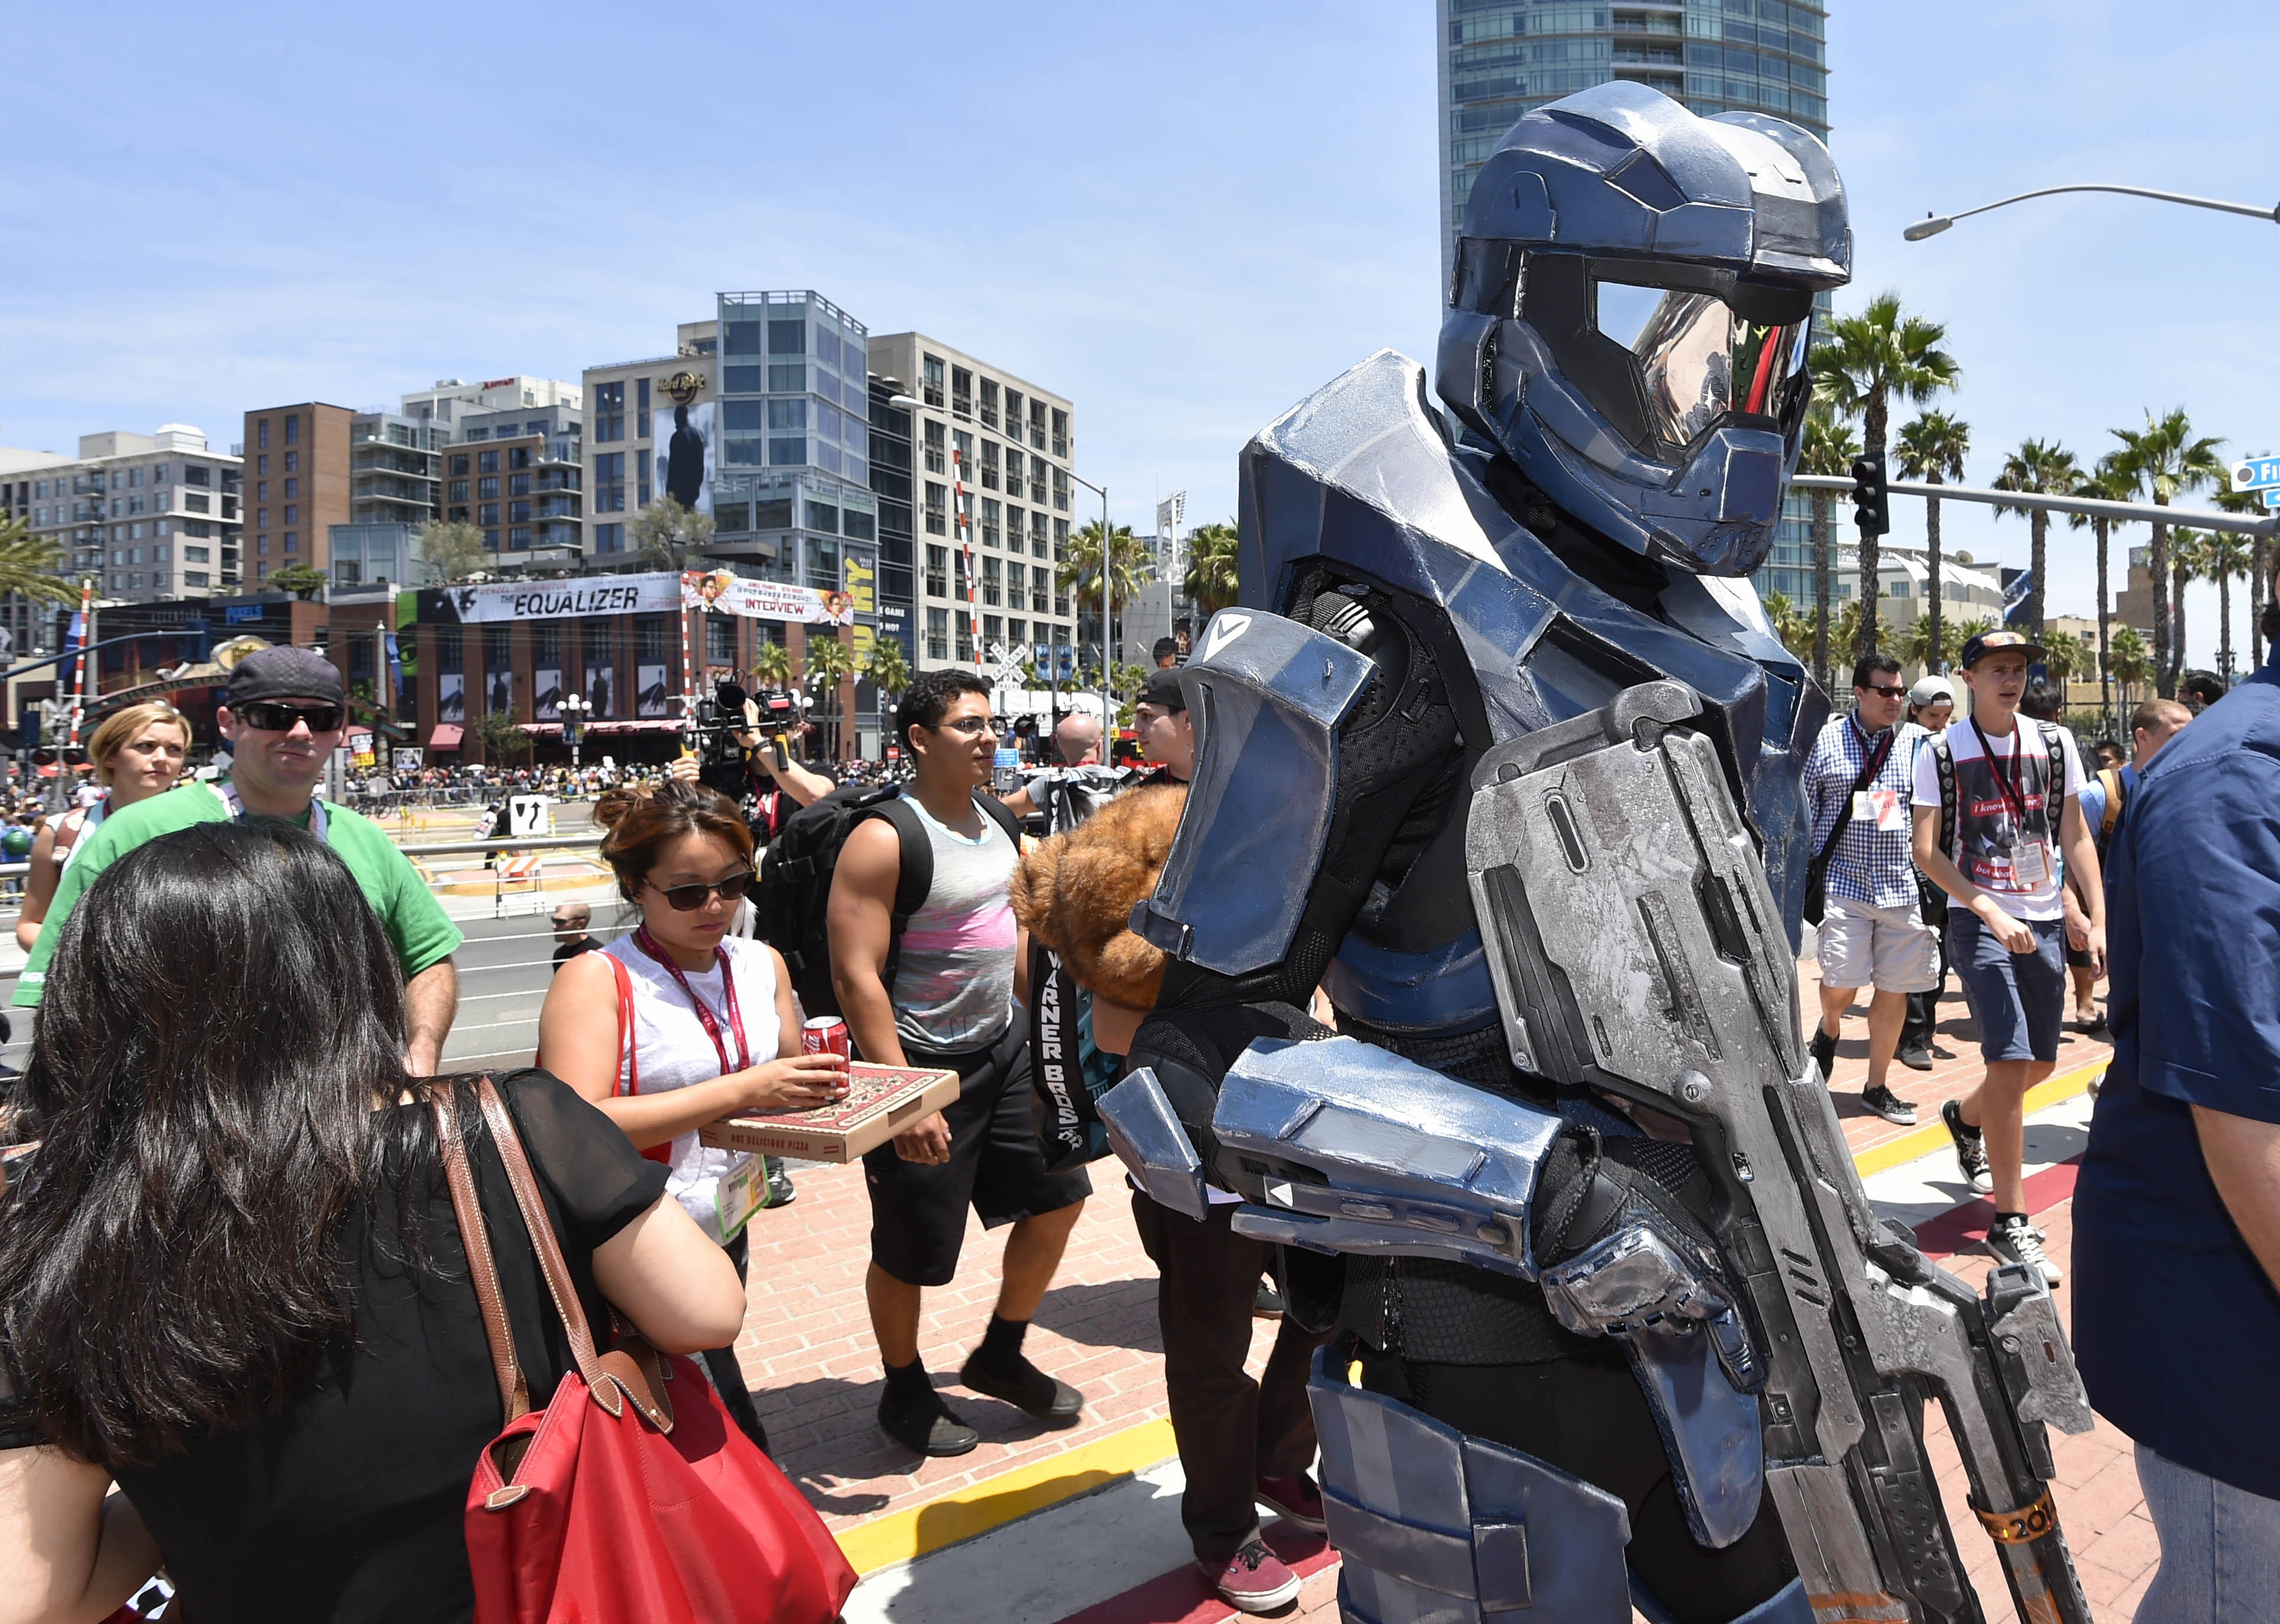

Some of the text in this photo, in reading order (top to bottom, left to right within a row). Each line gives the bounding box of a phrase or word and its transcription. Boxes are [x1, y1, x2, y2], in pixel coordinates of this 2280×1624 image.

[500, 594, 515, 603] THE
[515, 587, 639, 616] EQUALIZER
[746, 598, 805, 614] INTERVIEW
[885, 607, 905, 617] GAME
[885, 622, 900, 633] NOT
[993, 647, 1025, 678] CROSSING
[1976, 864, 1990, 874] but
[1041, 950, 1064, 1060] WARNER
[1043, 1065, 1079, 1124] BROS
[731, 1133, 809, 1152] HOT DELICIOUS PIZZA
